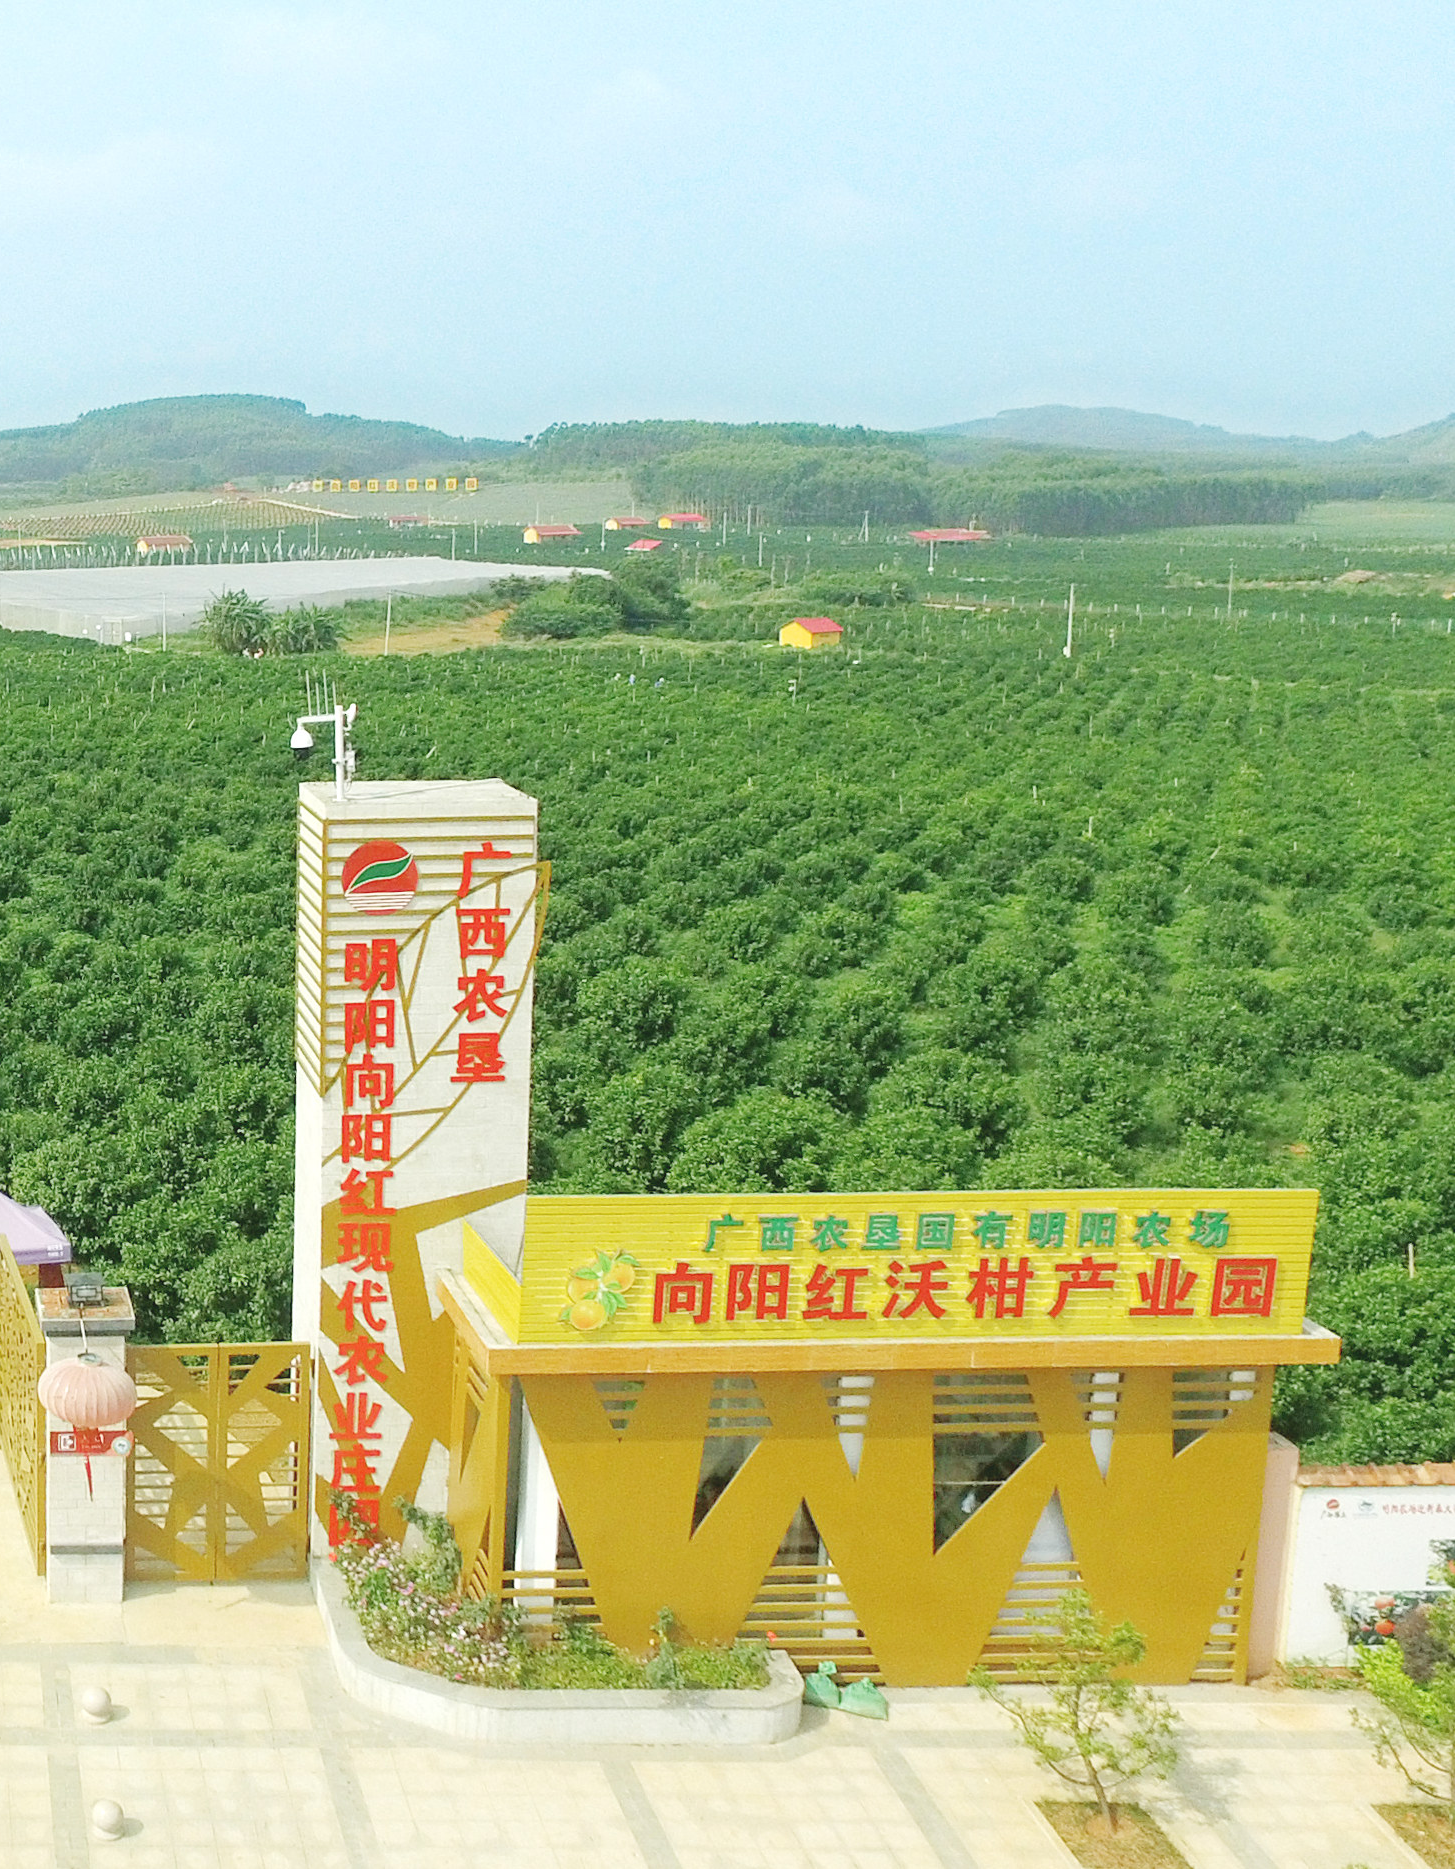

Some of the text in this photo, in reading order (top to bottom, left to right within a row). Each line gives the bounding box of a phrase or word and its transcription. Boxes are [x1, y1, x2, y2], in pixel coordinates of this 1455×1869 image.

[450, 841, 513, 1083] 广西农垦
[328, 938, 398, 1547] 明阳向阳红现代农业庄园
[651, 1256, 1278, 1325] 向阳红沃柑产业园
[702, 1209, 1232, 1253] 广西农垦国有明阳农场
